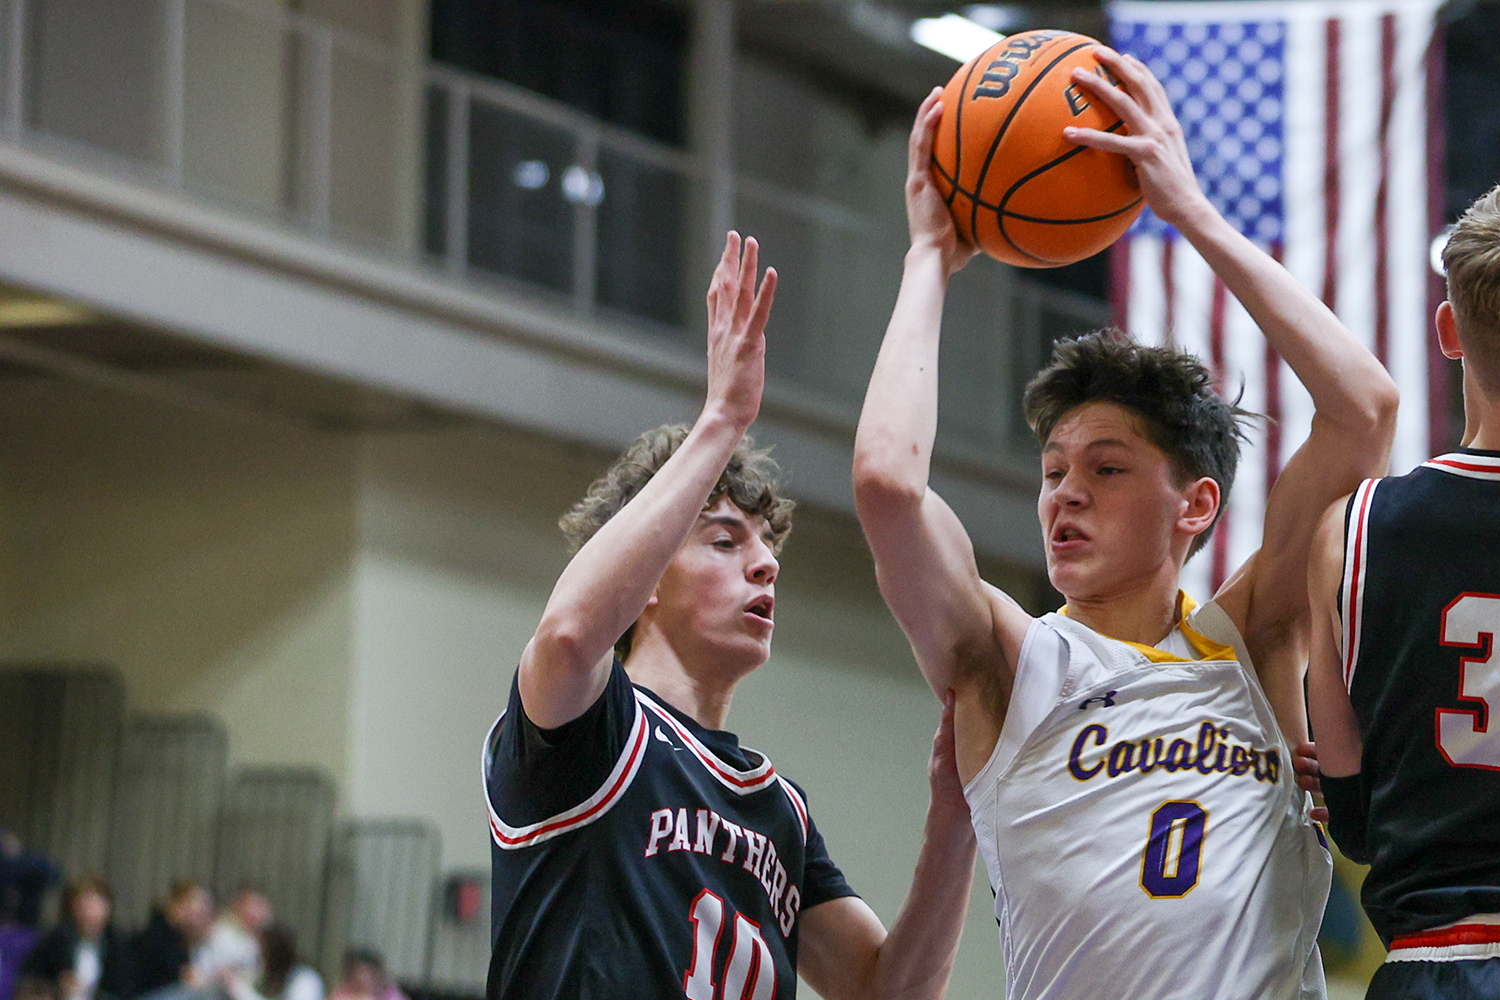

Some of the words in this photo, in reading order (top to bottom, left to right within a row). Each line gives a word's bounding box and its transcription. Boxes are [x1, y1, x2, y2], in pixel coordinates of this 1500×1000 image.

[971, 30, 1062, 101] Wils
[644, 807, 800, 938] PANTHERS
[1138, 799, 1210, 899] 0
